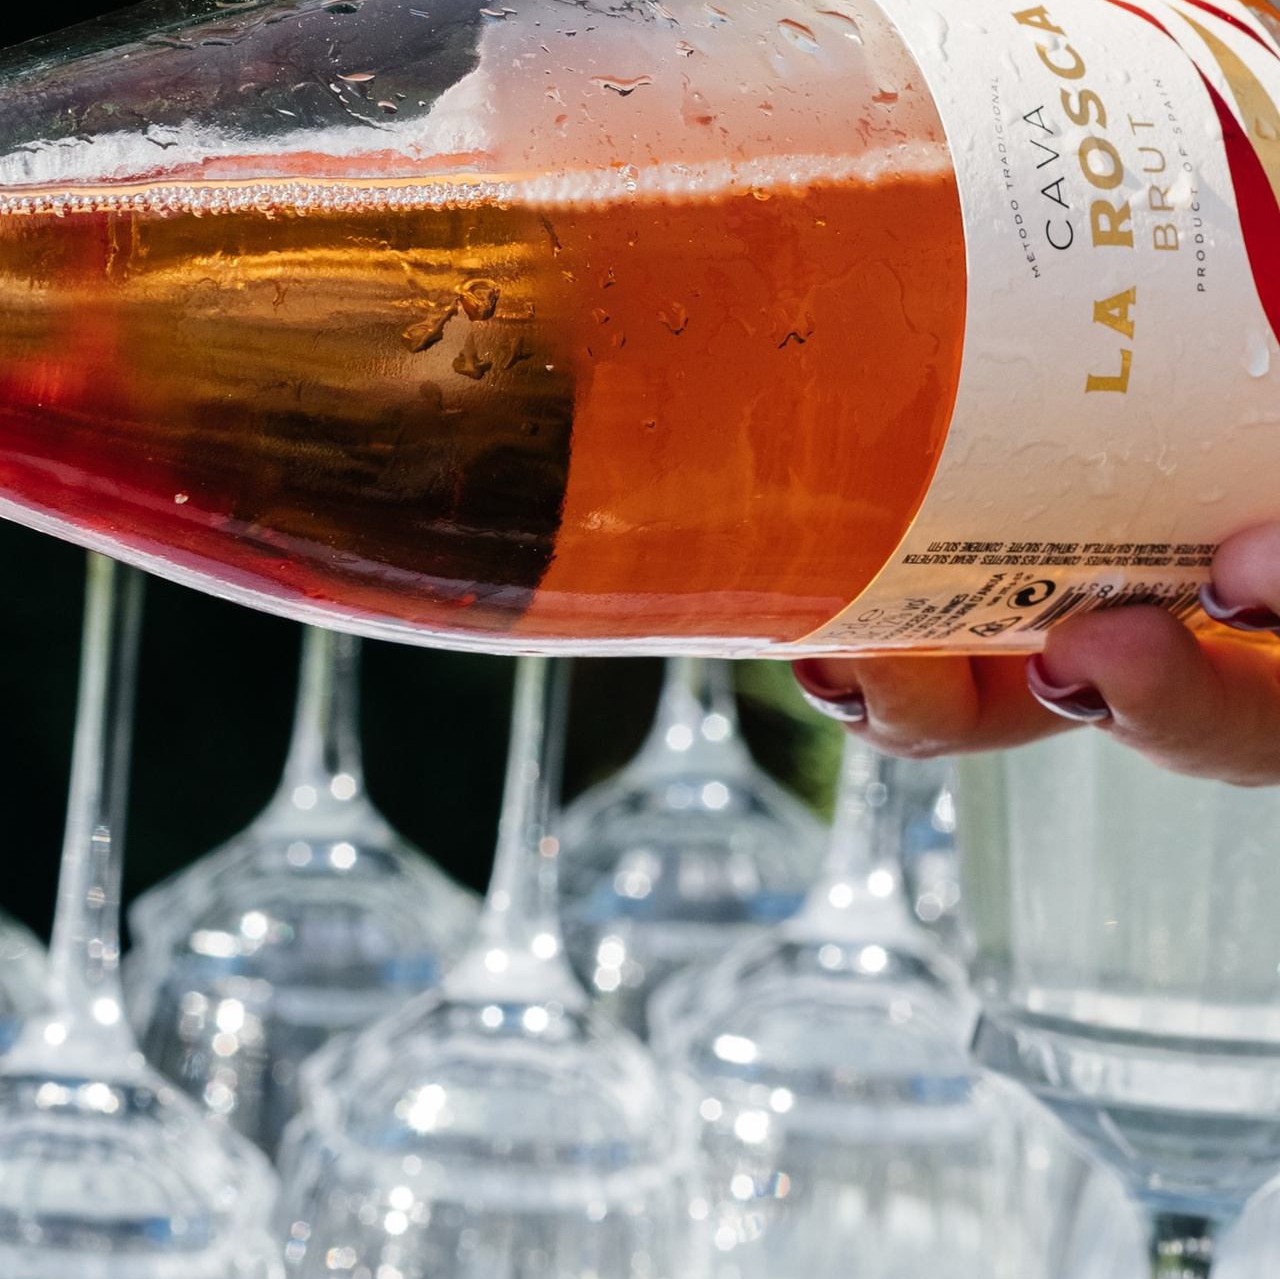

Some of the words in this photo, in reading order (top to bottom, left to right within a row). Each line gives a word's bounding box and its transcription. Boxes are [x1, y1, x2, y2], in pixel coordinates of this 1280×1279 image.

[991, 76, 1013, 190] TRADICIONAL
[1011, 5, 1135, 249] ROSCA
[1153, 78, 1183, 135] SPAIN
[1179, 146, 1194, 172] OF
[1023, 105, 1074, 250] CAVA
[1127, 113, 1180, 251] BRUT
[1191, 188, 1207, 292] PRODUCT
[1085, 286, 1137, 394] LA
